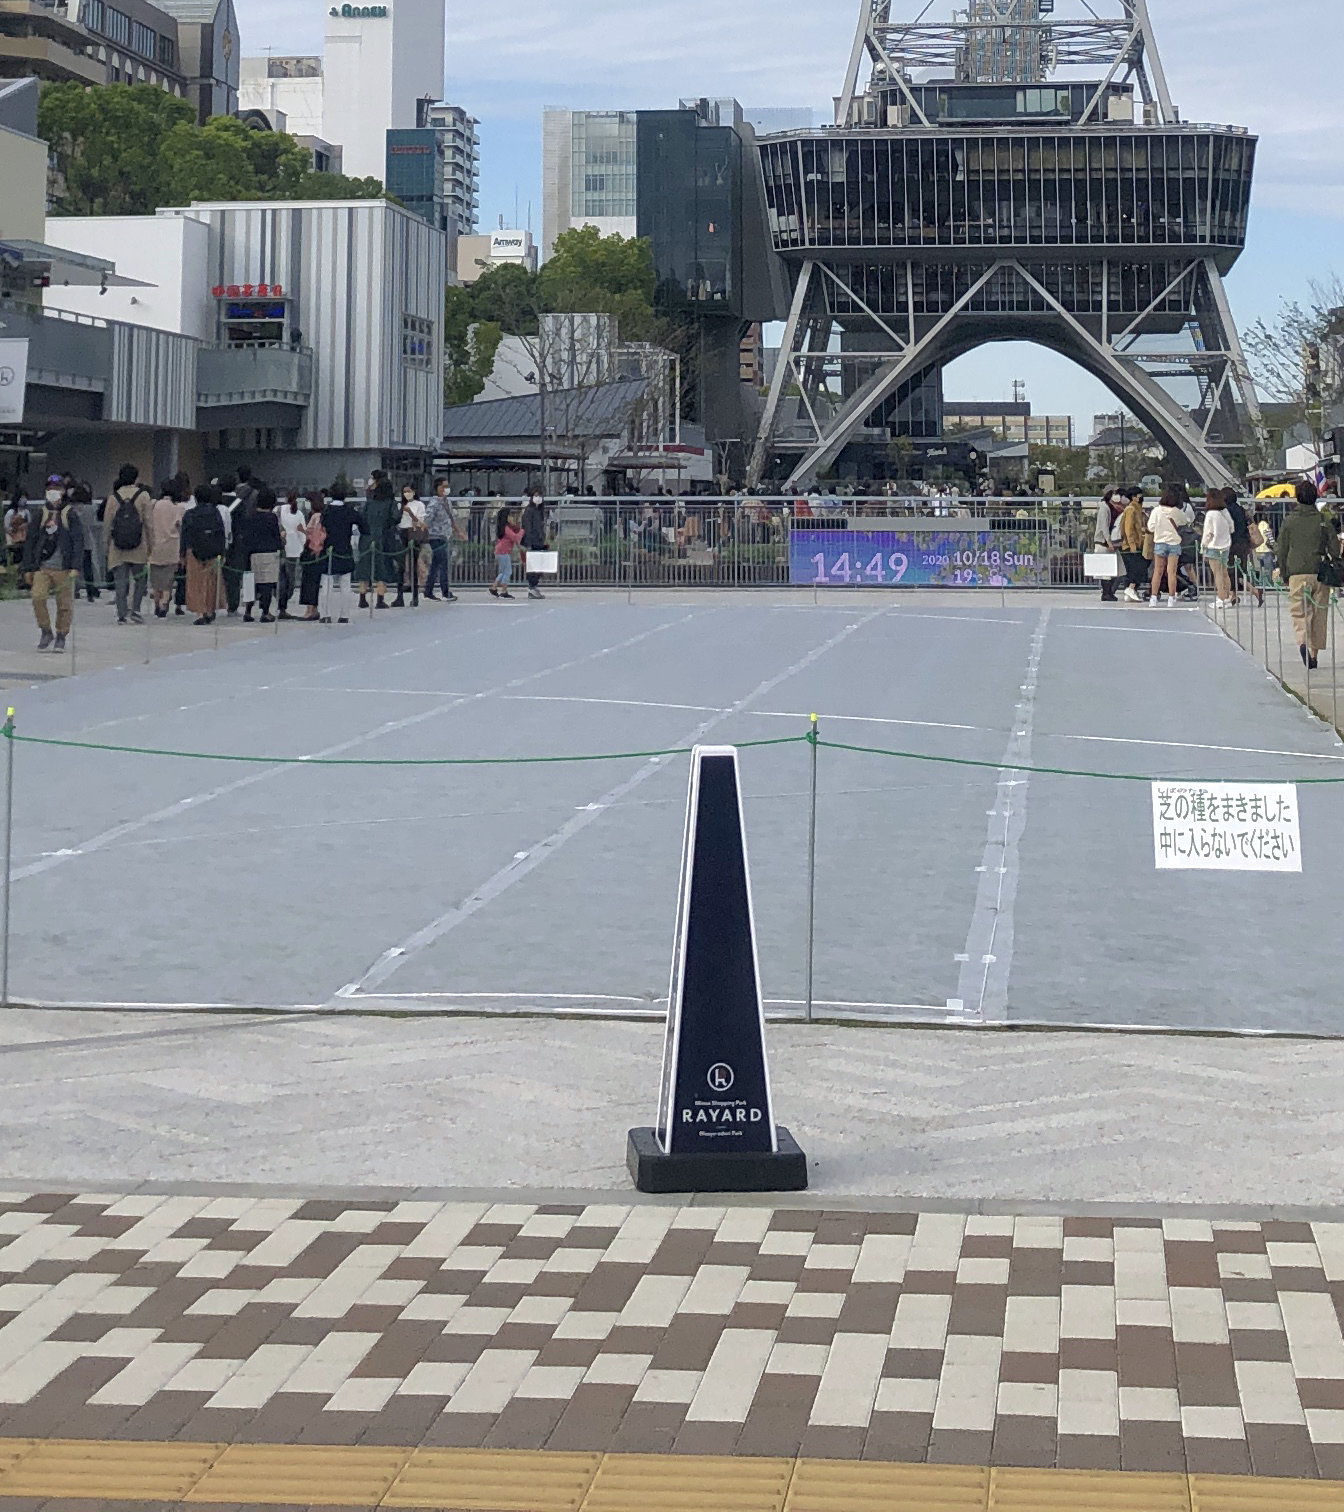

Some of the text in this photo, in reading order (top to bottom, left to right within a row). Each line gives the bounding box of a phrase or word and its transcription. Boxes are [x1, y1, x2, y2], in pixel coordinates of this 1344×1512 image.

[493, 237, 523, 247] Amway
[811, 552, 908, 583] 14:49
[922, 551, 1033, 566] 2020 10/18 Sun
[1158, 791, 1292, 823] 芝の種をまきました
[1159, 827, 1295, 861] 中に入らないでください
[682, 1108, 762, 1122] RAYARD
